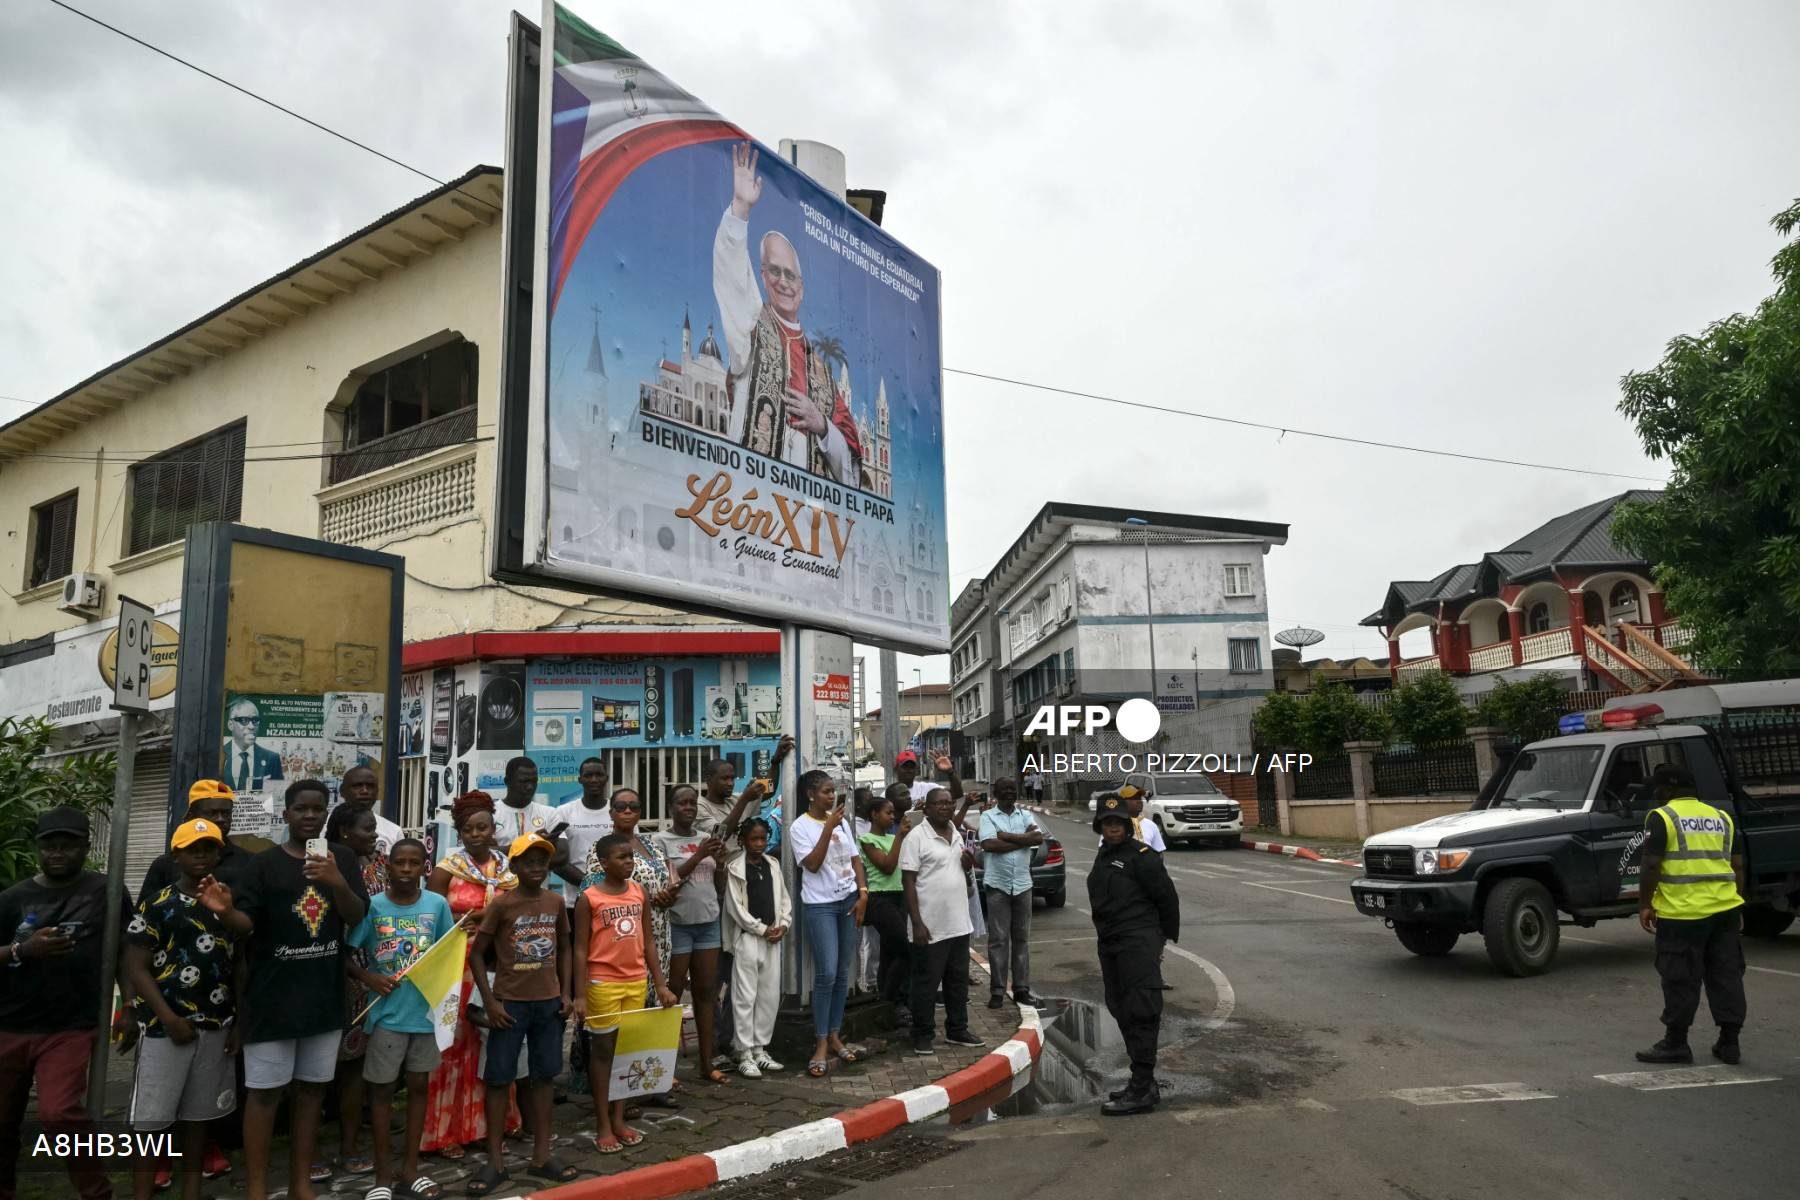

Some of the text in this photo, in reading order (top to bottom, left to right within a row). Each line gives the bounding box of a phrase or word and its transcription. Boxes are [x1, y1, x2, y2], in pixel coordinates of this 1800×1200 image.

[800, 200, 925, 293] "CRISTO, LUZ DE GUINEA ECUATORIAL
[805, 221, 829, 247] HACIA
[830, 237, 841, 254] UN
[841, 245, 869, 272] FUTURO
[870, 263, 880, 279] DE
[642, 421, 895, 525] BIENVENIDO SU SANTIDAD EL PAPA
[675, 470, 855, 565] León XIV
[719, 535, 841, 579] a Guinea Ecuatorial
[151, 650, 178, 663] iguel
[540, 663, 573, 676] TIENDA
[401, 673, 424, 698] ONICA
[816, 690, 829, 699] 222
[47, 695, 102, 721] Restaurante
[266, 729, 307, 737] NZALANG
[542, 755, 576, 764] TIENDA
[1681, 818, 1724, 832] POLICIA
